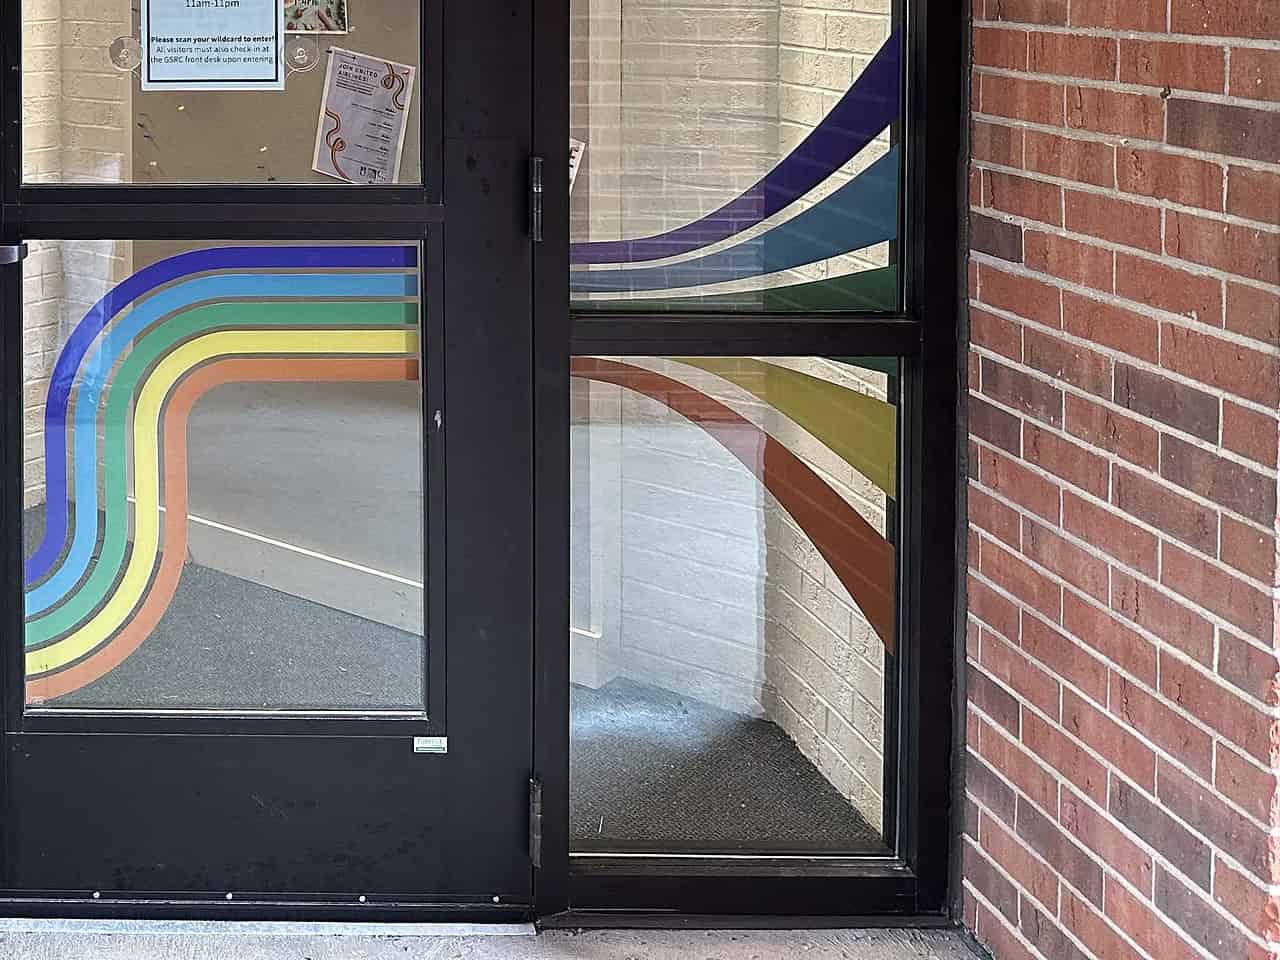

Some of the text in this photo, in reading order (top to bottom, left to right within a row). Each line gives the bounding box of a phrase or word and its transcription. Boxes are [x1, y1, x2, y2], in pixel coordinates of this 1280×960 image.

[185, 0, 240, 9] 11am-11pm
[211, 35, 242, 43] wildcard
[222, 57, 241, 65] upon
